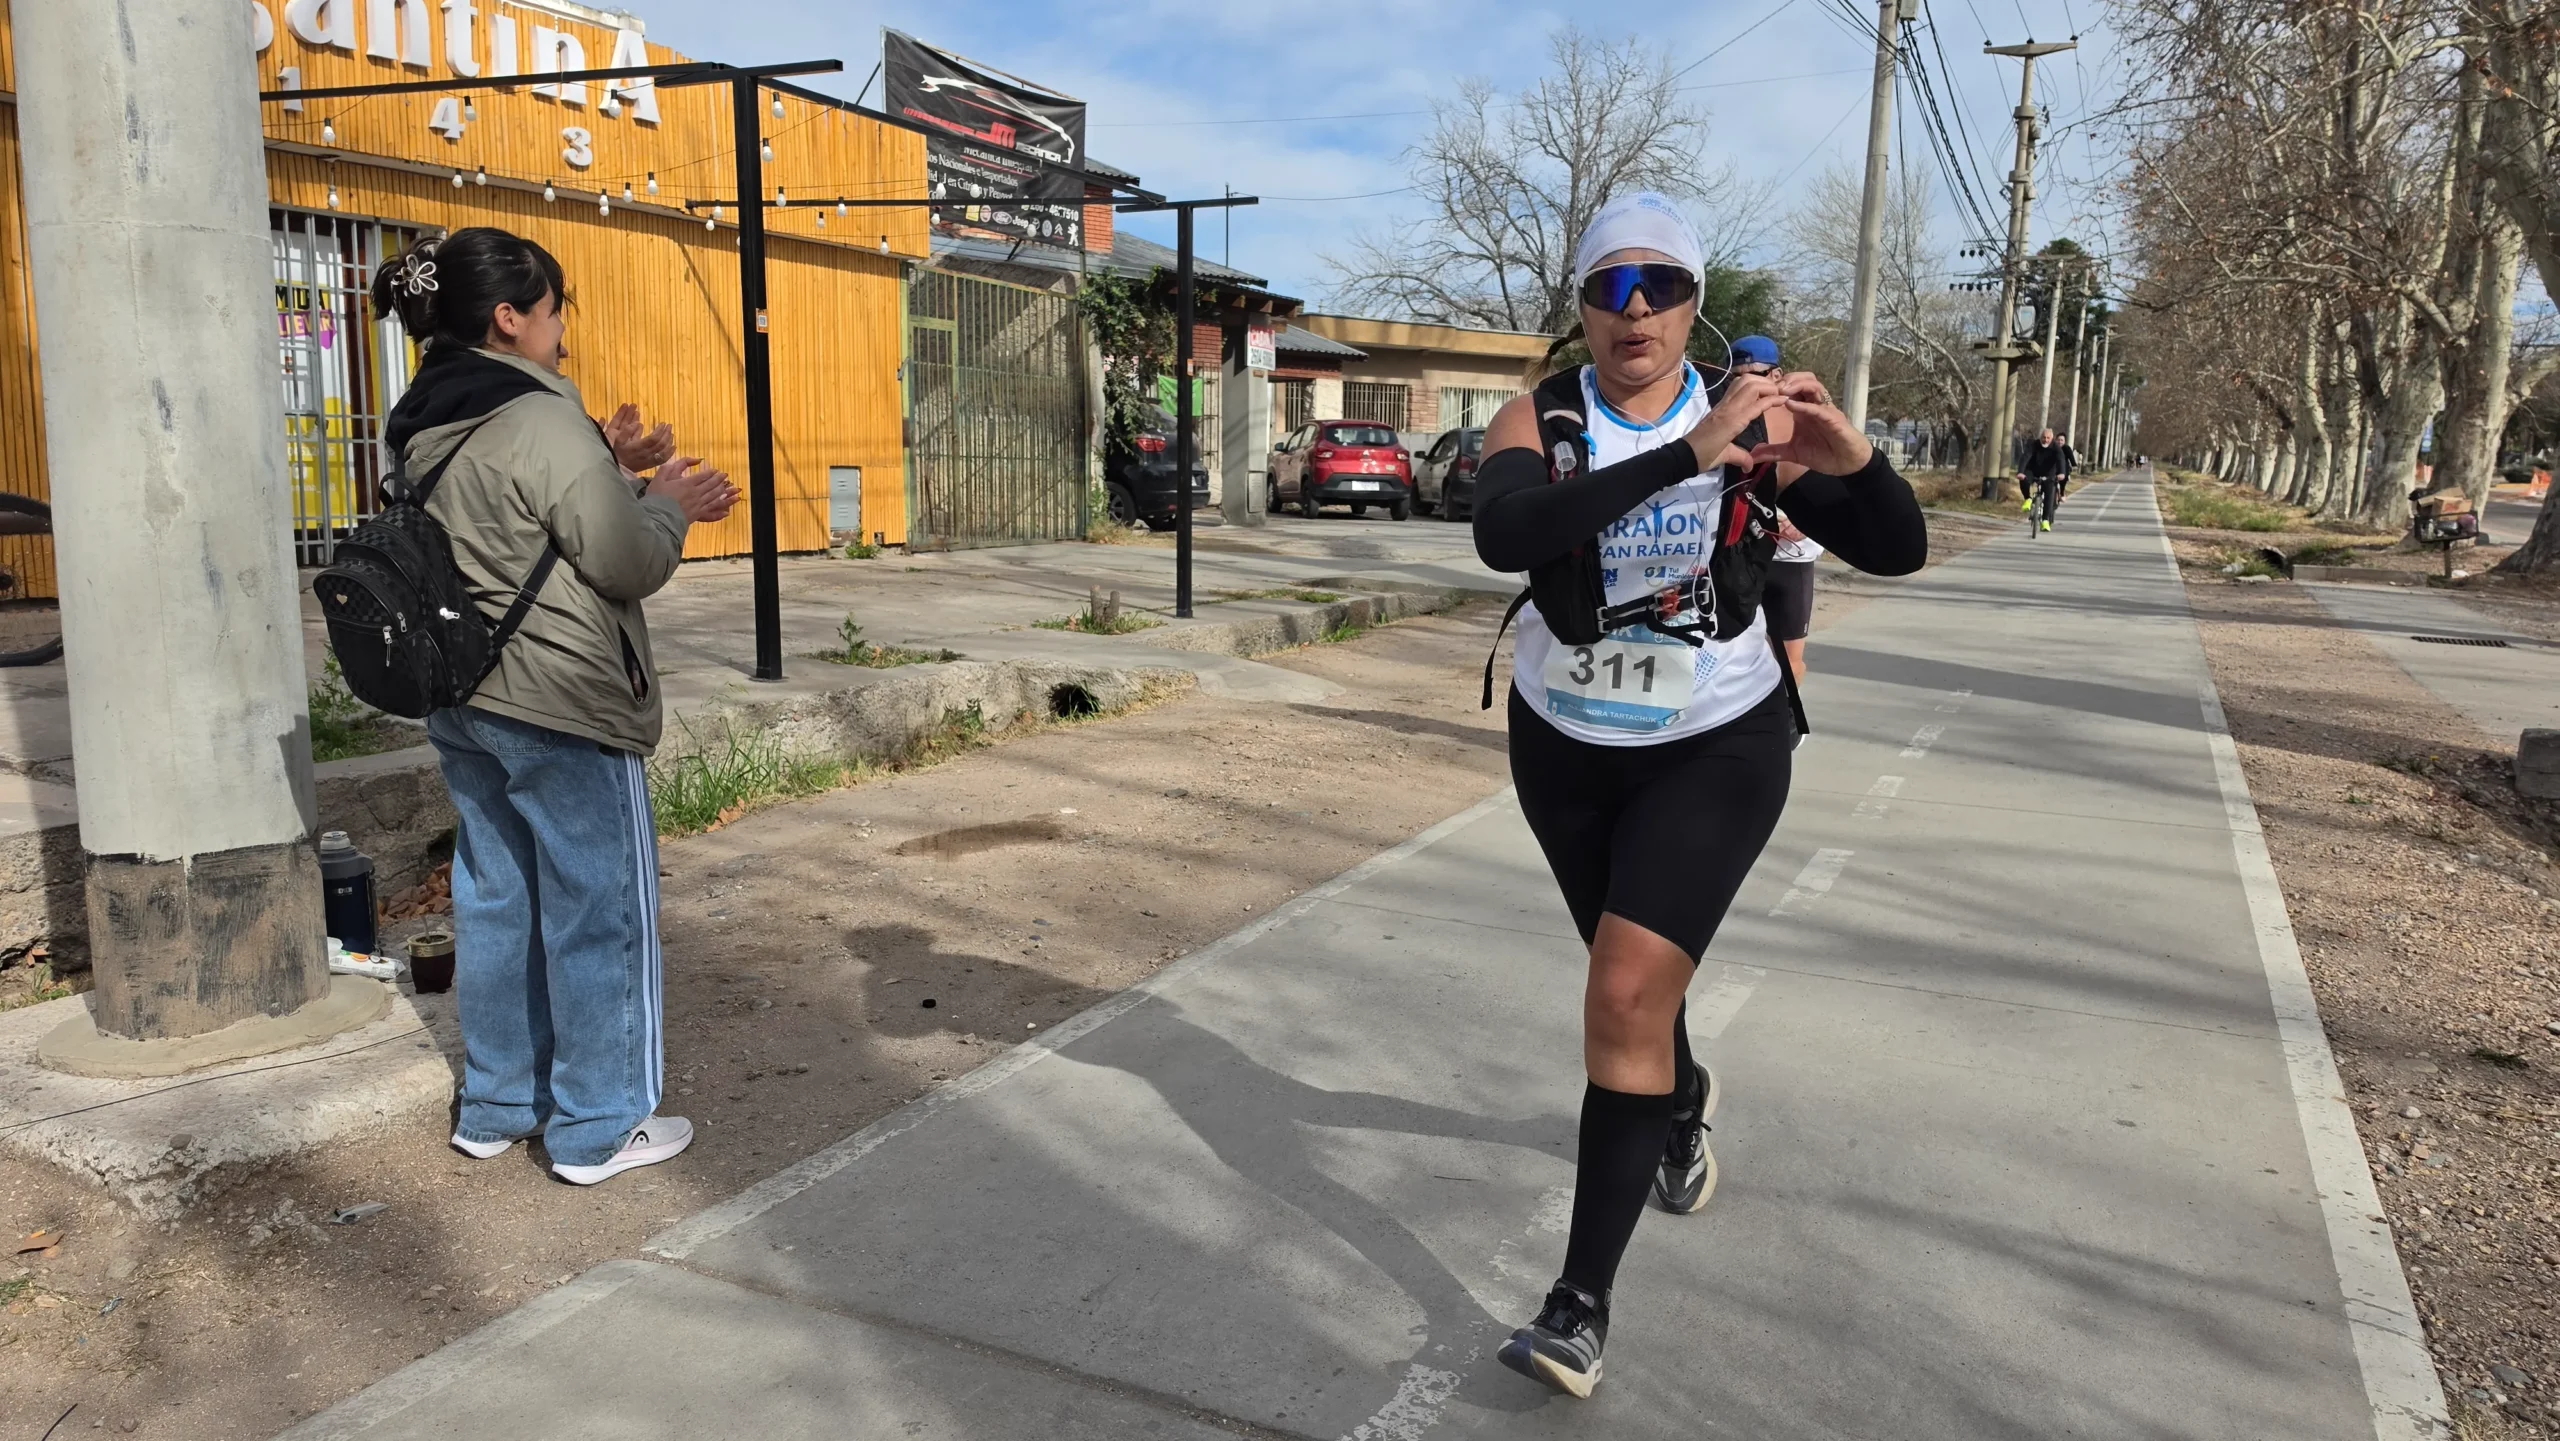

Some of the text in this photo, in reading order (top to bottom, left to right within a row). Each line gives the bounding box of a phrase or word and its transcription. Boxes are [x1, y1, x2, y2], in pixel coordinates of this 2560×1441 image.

[938, 153, 976, 174] Nacionales
[1012, 215, 1029, 229] Jeep
[1636, 541, 1706, 557] RAFAEL
[1568, 646, 1656, 693] 311
[1610, 711, 1658, 724] TARTACHUK
